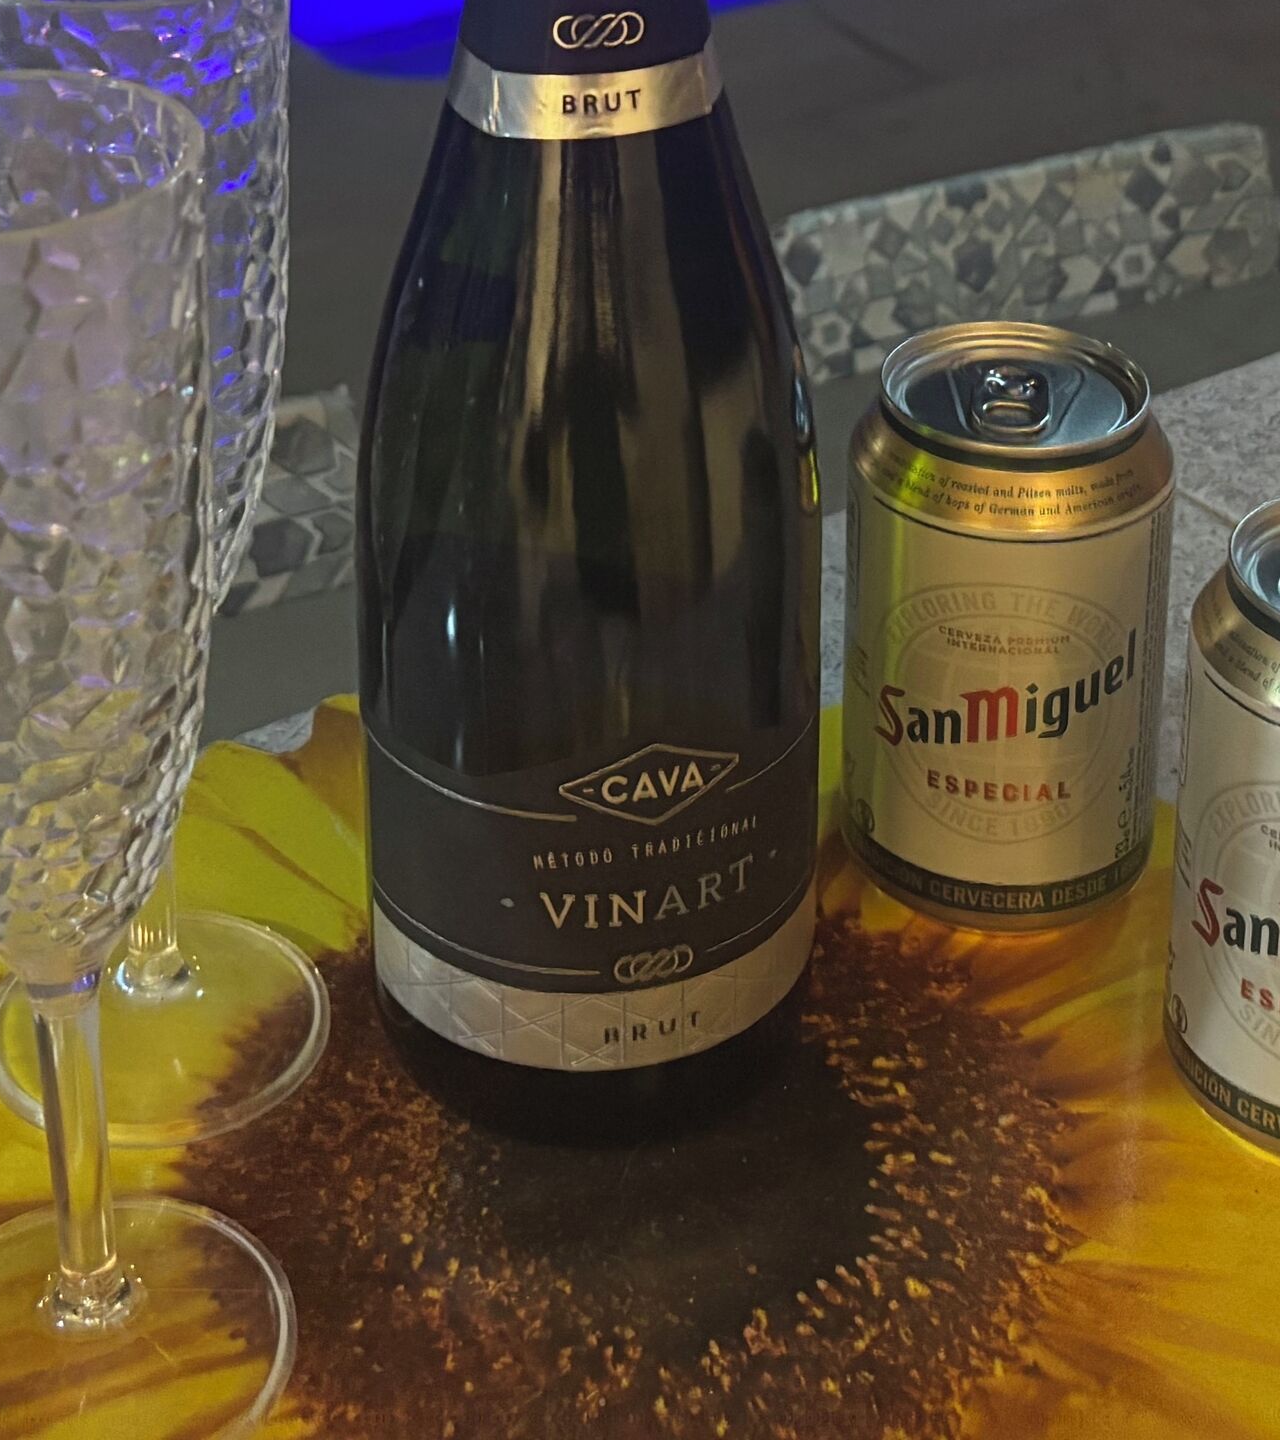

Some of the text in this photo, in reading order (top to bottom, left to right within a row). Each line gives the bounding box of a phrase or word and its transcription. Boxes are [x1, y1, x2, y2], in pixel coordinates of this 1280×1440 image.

[562, 89, 642, 115] BRUT
[993, 486, 1014, 499] and
[1010, 591, 1062, 619] THE
[938, 624, 1002, 645] CERVEZA
[946, 636, 1060, 656] INTERNACIONAL
[874, 627, 1136, 746] SanMiguel
[601, 761, 705, 805] CAVA
[927, 769, 1071, 803] ESPECIAL
[926, 791, 998, 837] SINCE
[539, 852, 754, 929] VINART
[929, 875, 1107, 909] CERVECERA DESDE
[604, 1010, 702, 1044] BRUT
